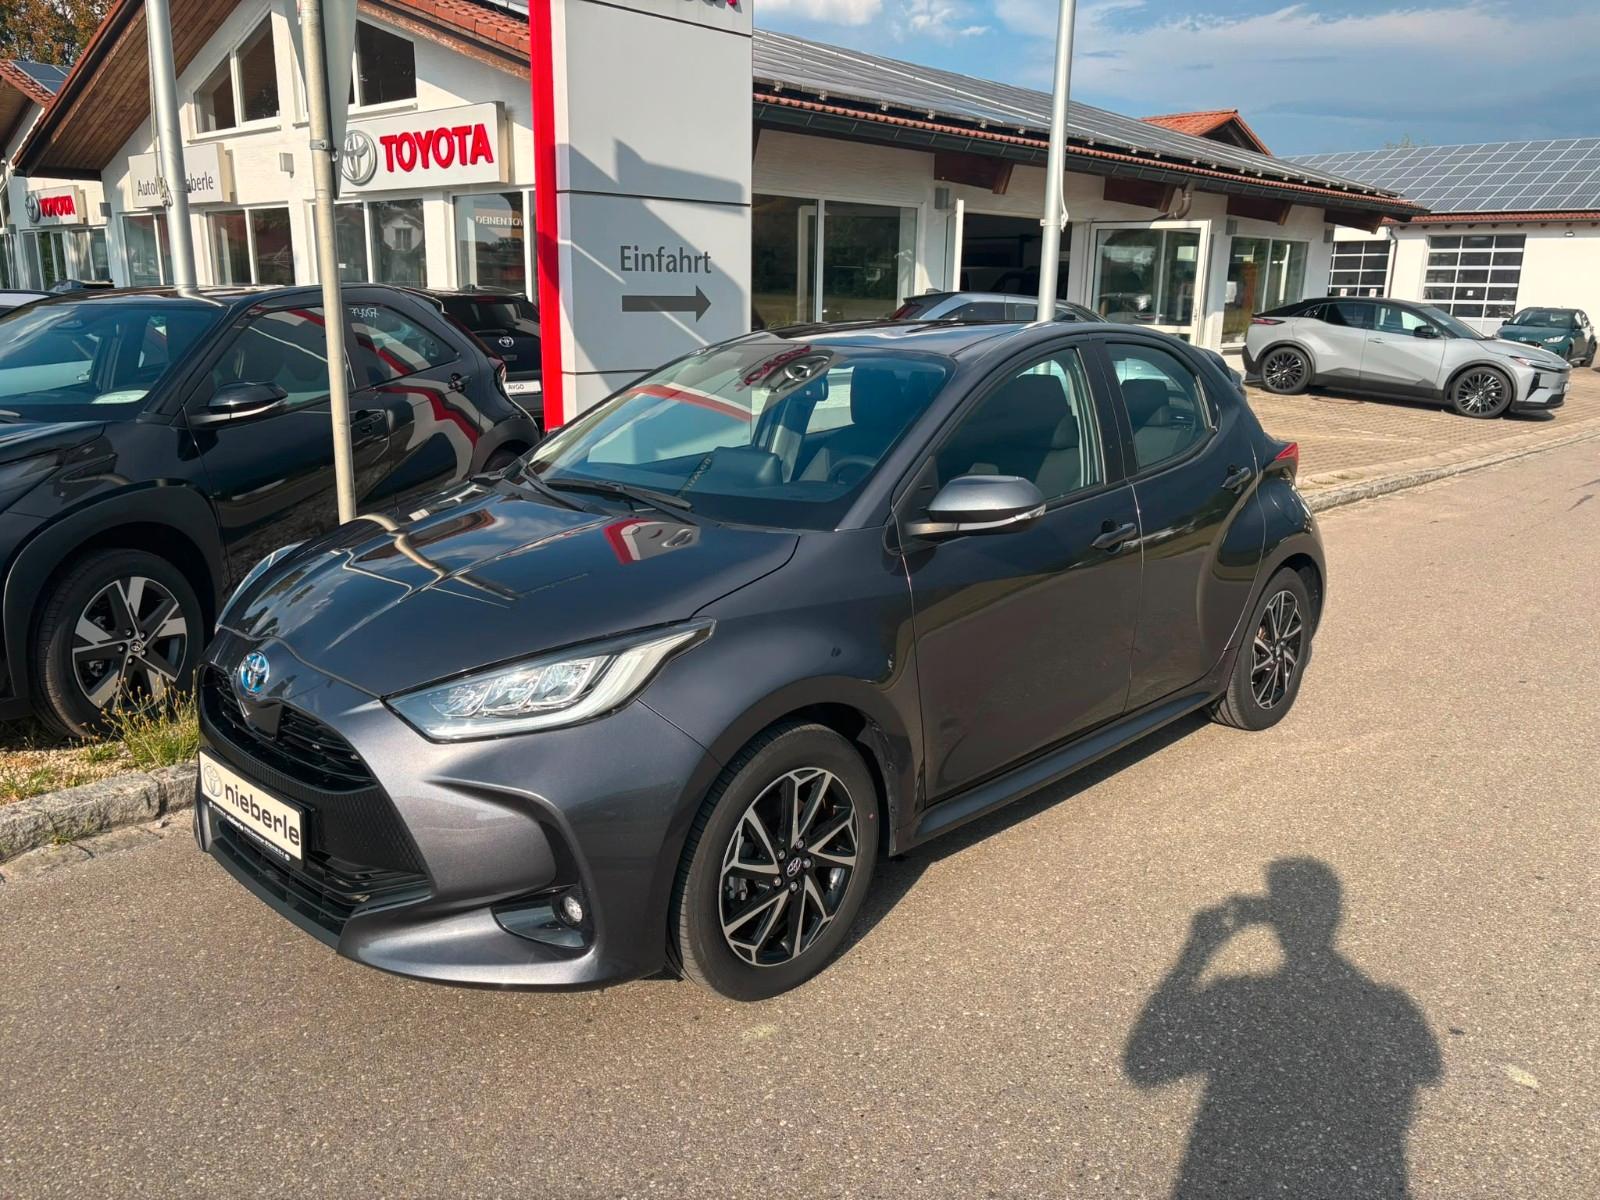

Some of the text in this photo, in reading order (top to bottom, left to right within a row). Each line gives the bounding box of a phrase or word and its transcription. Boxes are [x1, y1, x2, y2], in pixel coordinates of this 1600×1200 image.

[380, 123, 494, 173] TOYOTA
[39, 195, 76, 217] TOYOTA
[619, 245, 712, 273] Einfahrt
[225, 783, 300, 846] nieberle
